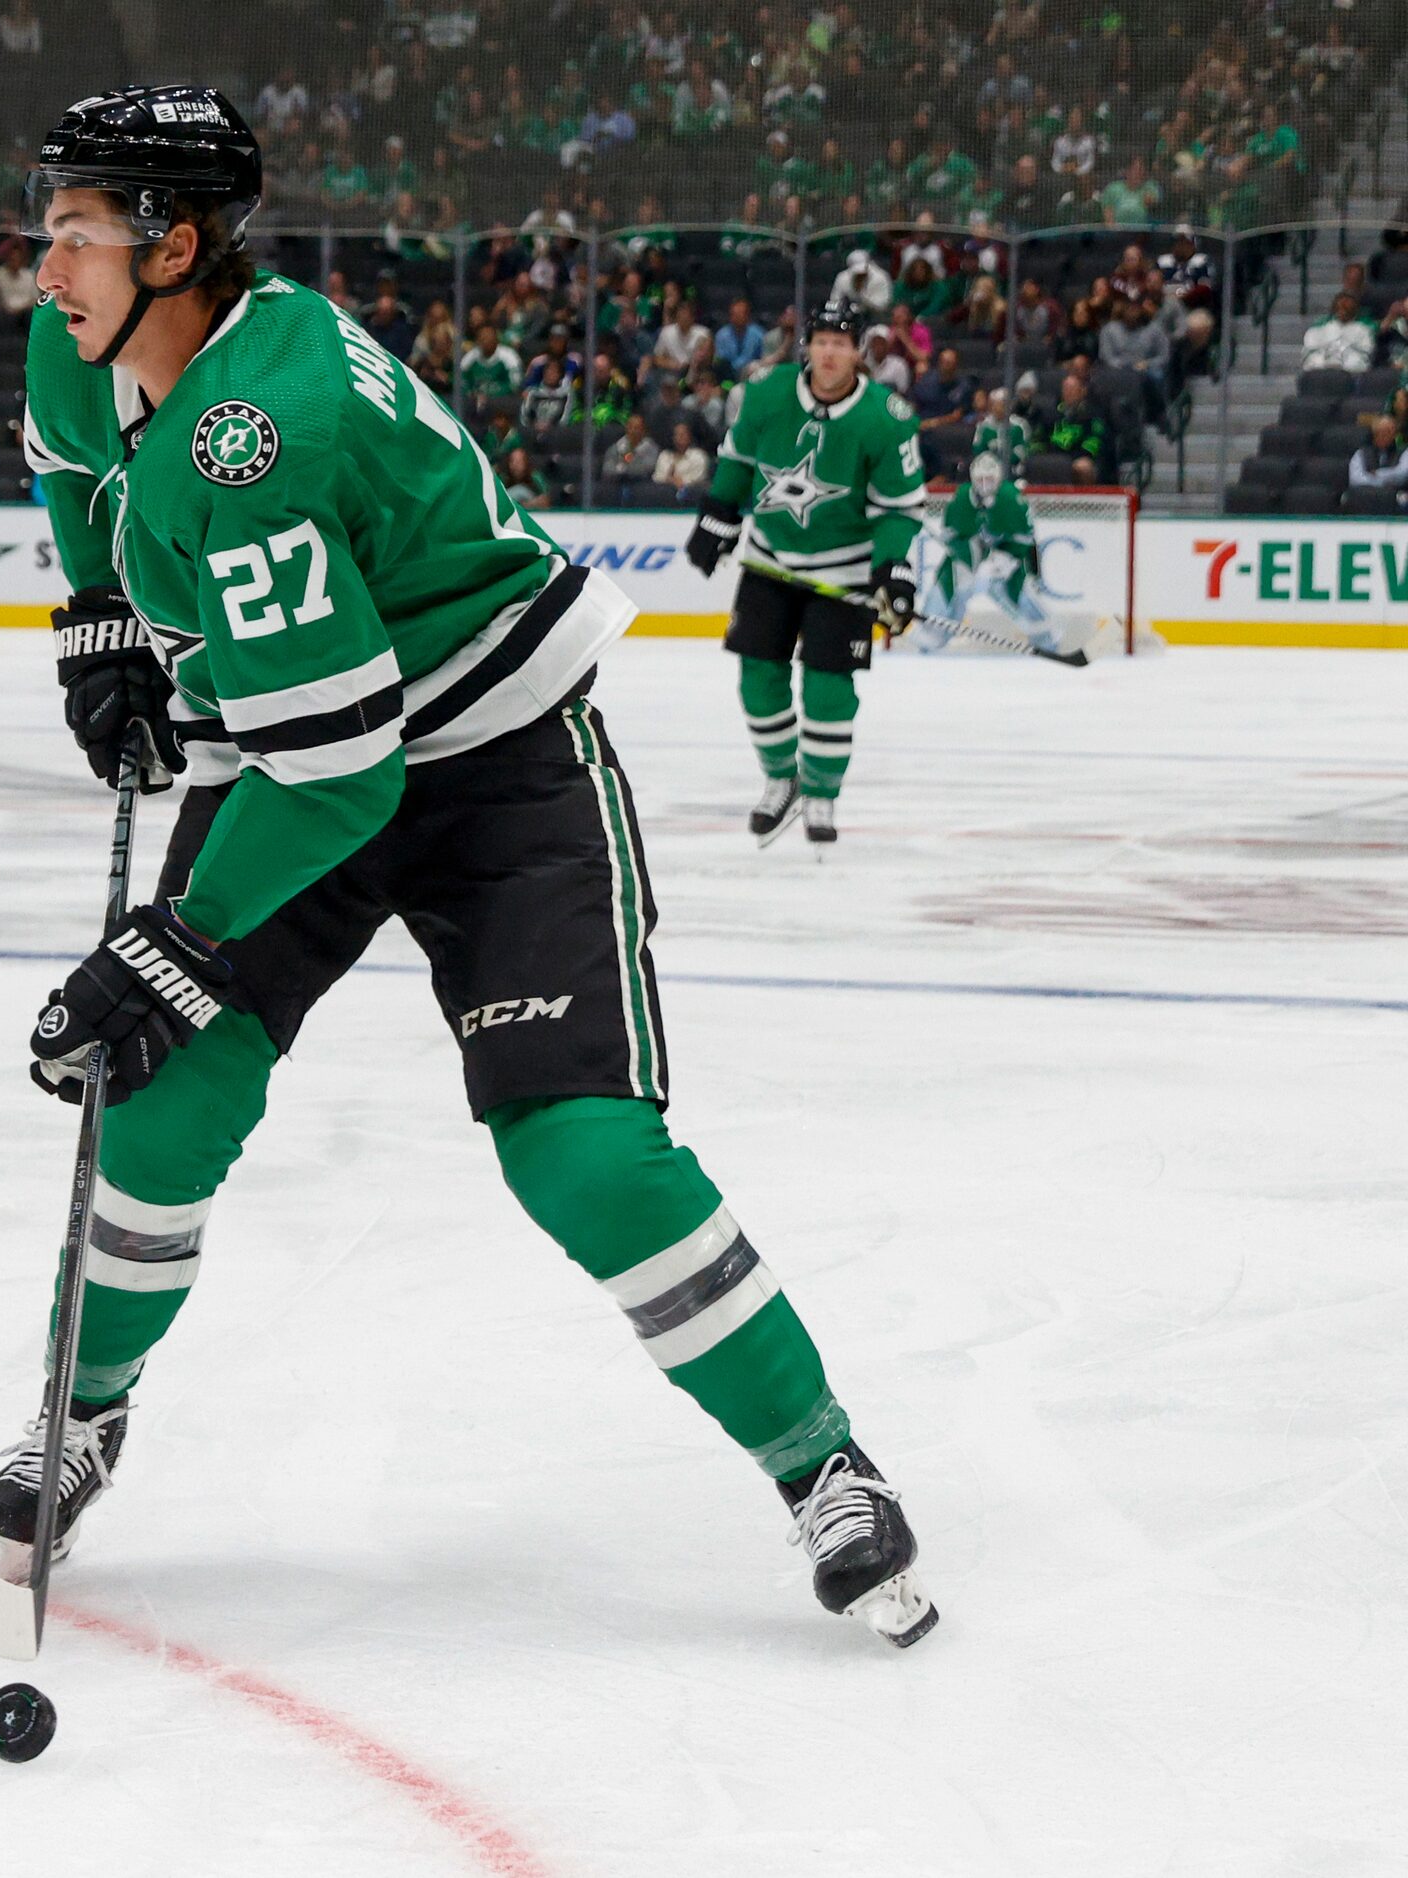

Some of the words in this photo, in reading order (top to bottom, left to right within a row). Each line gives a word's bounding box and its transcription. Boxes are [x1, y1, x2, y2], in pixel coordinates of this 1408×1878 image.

[41, 145, 65, 155] CCM
[196, 406, 264, 453] DALLAS
[210, 442, 273, 479] STARS
[561, 543, 676, 571] ING
[1192, 540, 1408, 602] 7-ELEV
[207, 518, 335, 641] 27
[89, 690, 117, 723] COVERT
[163, 916, 212, 963] MARCHMENT
[459, 994, 574, 1039] CCM
[139, 1036, 150, 1074] COVERT
